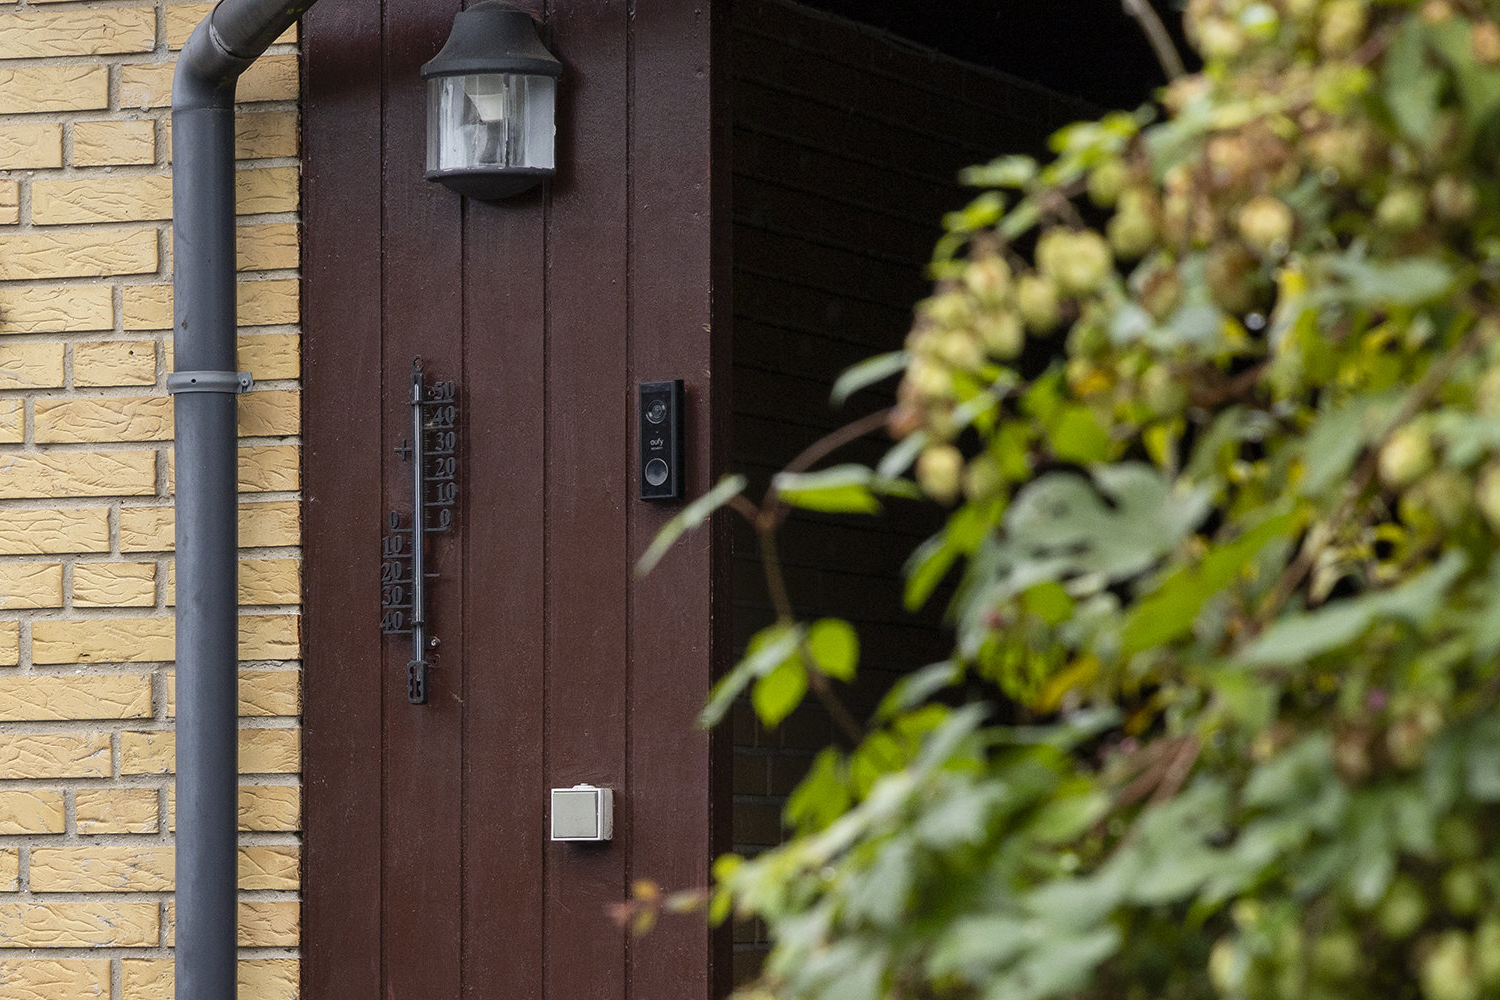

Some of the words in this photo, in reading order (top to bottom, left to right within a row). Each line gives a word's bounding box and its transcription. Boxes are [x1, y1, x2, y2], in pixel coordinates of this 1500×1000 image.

[432, 381, 456, 401] 50
[432, 406, 456, 426] 40
[435, 431, 456, 451] 30
[435, 457, 456, 477] 20
[436, 482, 457, 502] 10
[388, 510, 399, 529] 0
[439, 508, 451, 528] 0
[382, 535, 403, 555] 10
[381, 561, 402, 581] 20
[381, 586, 403, 605] 30
[380, 611, 403, 630] 40
